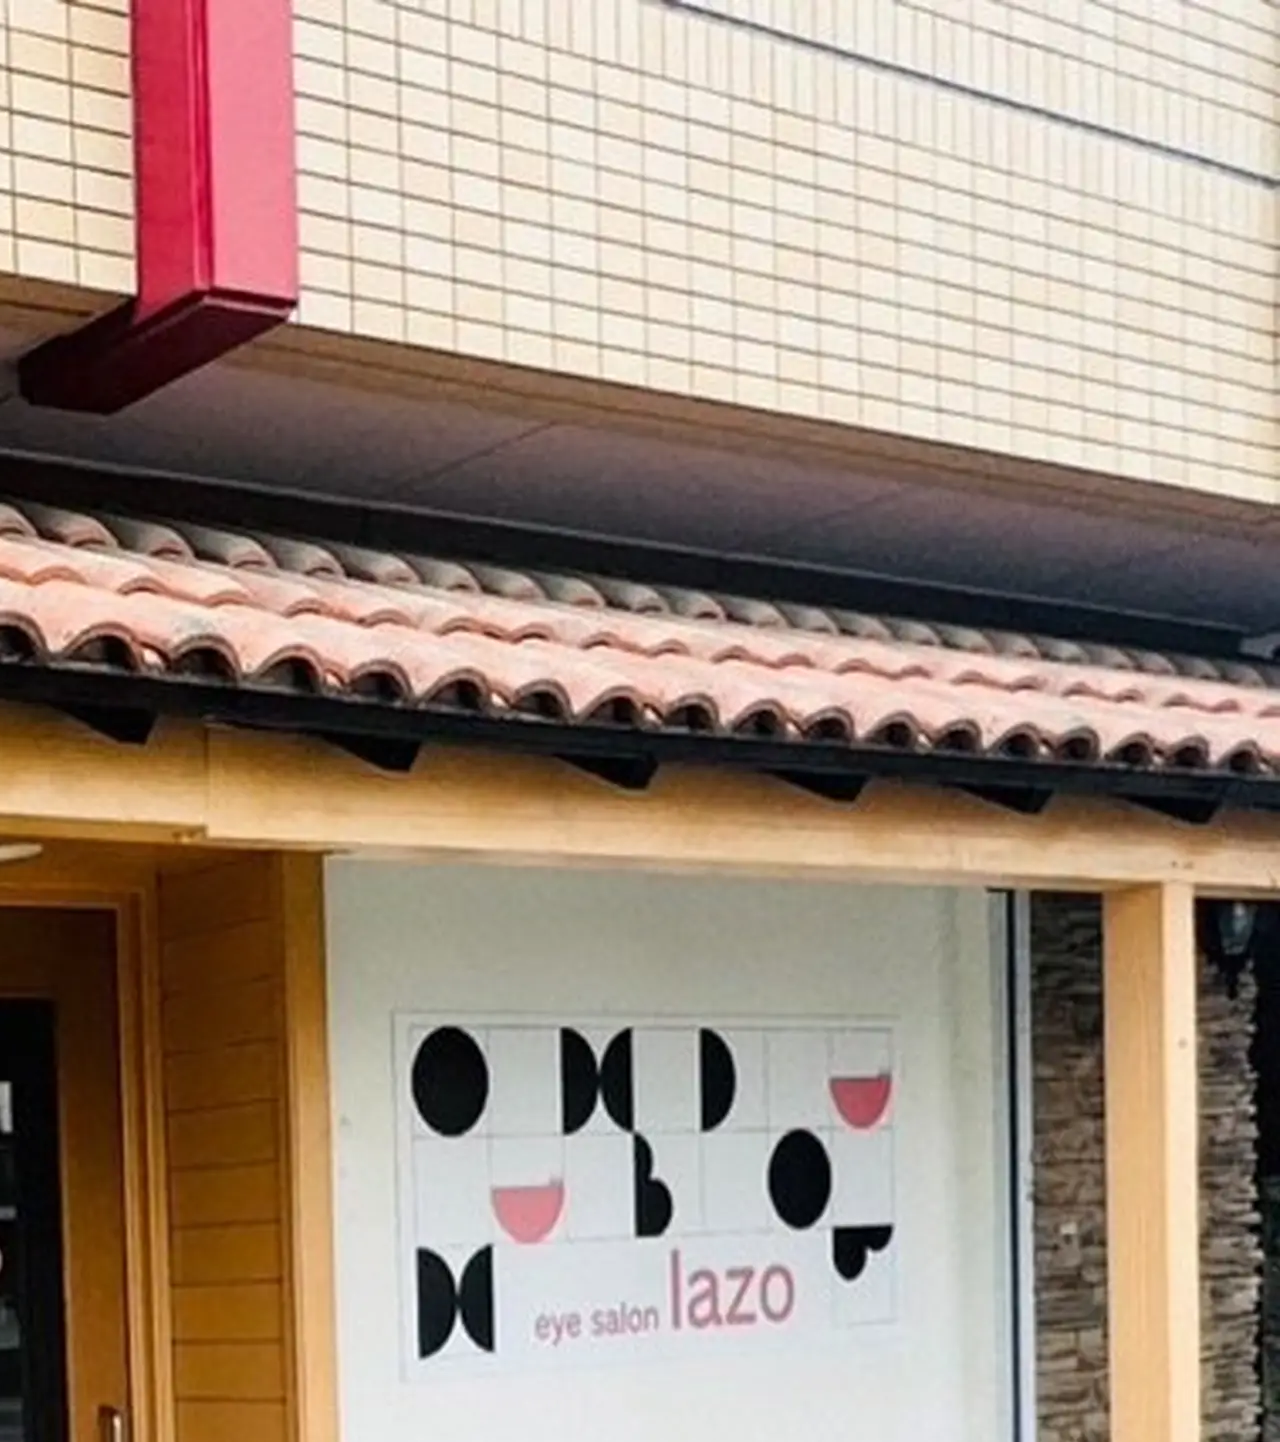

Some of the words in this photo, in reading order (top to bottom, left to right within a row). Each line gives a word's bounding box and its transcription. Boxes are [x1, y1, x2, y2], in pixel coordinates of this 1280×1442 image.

[534, 1311, 582, 1347] eye
[590, 1300, 660, 1337] salon
[671, 1248, 795, 1329] lazo
